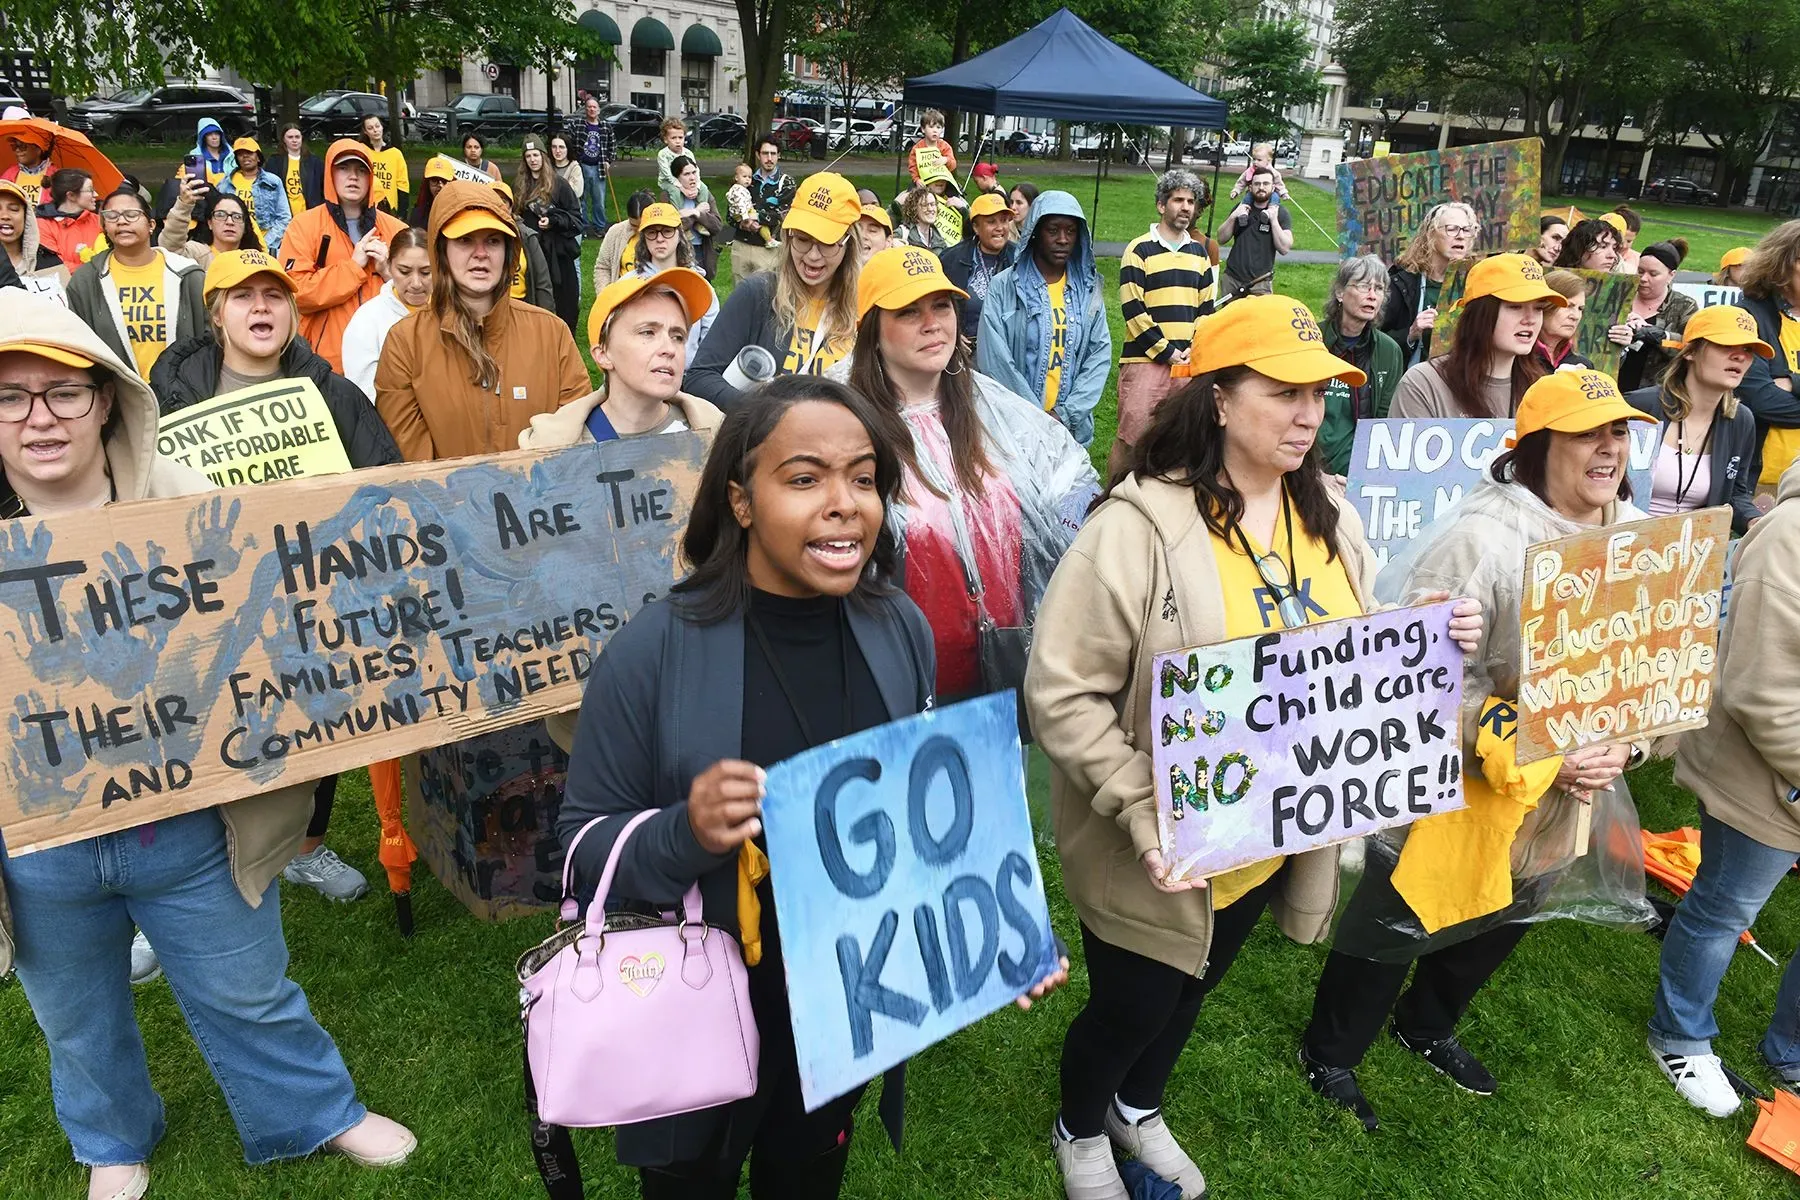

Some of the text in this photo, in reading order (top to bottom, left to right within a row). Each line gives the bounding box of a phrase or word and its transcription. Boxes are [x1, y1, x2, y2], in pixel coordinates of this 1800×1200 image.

[808, 199, 830, 212] CARE
[810, 192, 833, 204] CHILD
[817, 186, 831, 195] FIX
[1352, 155, 1507, 205] EDUCATE THE
[902, 259, 933, 270] CHILD
[904, 251, 923, 260] FIX
[907, 266, 936, 277] CARE
[119, 286, 155, 303] FIX
[201, 421, 330, 468] AFFORDABLE
[220, 410, 247, 436] IF
[248, 396, 307, 428] YOU
[247, 455, 305, 485] CARE
[1366, 422, 1454, 474] NO
[1360, 484, 1422, 541] THE
[0, 469, 673, 644] THESE HANDS ARE THE
[1532, 518, 1716, 617] Pay Early
[294, 568, 468, 654] FUTURE!
[1253, 577, 1329, 629] FX
[1522, 584, 1722, 676] Educators
[1253, 619, 1440, 684] Funding,
[1617, 630, 1717, 692] they're
[1245, 672, 1363, 733] Child
[1374, 666, 1455, 705] care,
[22, 695, 198, 767] THEIR
[102, 759, 193, 809] AND
[220, 681, 469, 769] COMMUNITY
[1170, 750, 1259, 821] NO
[1291, 708, 1447, 777] WORK
[814, 733, 975, 900] GO
[1272, 754, 1460, 848] FORCE!!
[835, 850, 1043, 1060] KIDS
